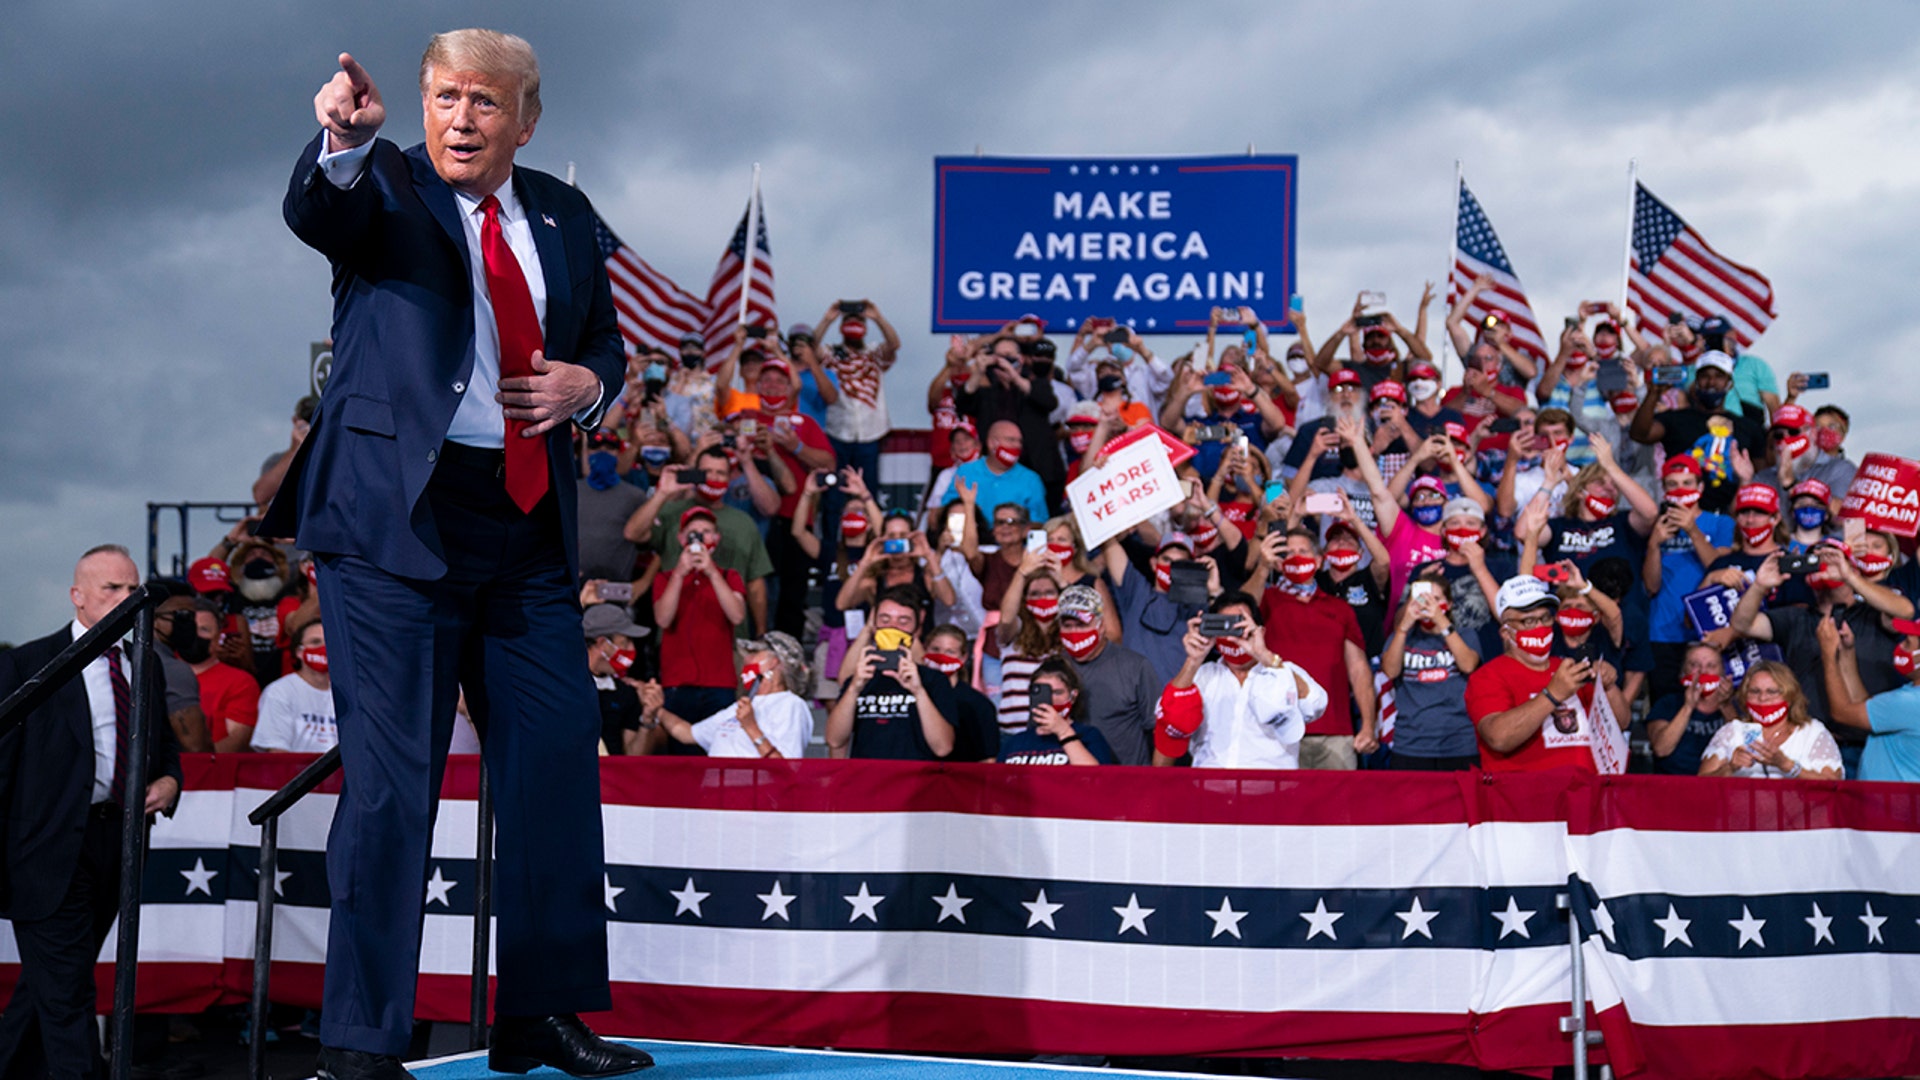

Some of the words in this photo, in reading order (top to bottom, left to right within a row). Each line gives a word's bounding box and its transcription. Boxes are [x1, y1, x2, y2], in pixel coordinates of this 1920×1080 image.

[1053, 190, 1172, 220] MAKE
[1014, 230, 1209, 261] AMERICA
[958, 271, 1097, 301] GREAT
[1113, 271, 1265, 301] AGAIN!
[1086, 491, 1096, 504] 4
[1099, 459, 1154, 496] MORE
[1092, 478, 1161, 521] YEARS!
[1863, 500, 1917, 524] AGAIN
[1562, 526, 1615, 547] TRUMP
[1284, 563, 1315, 574] TRUMP
[1326, 554, 1360, 566] TRUMP
[1558, 616, 1593, 627] TRUMP
[1061, 634, 1097, 652] TRUMP
[857, 694, 916, 706] TRUMP
[1748, 706, 1786, 723] TRUMP
